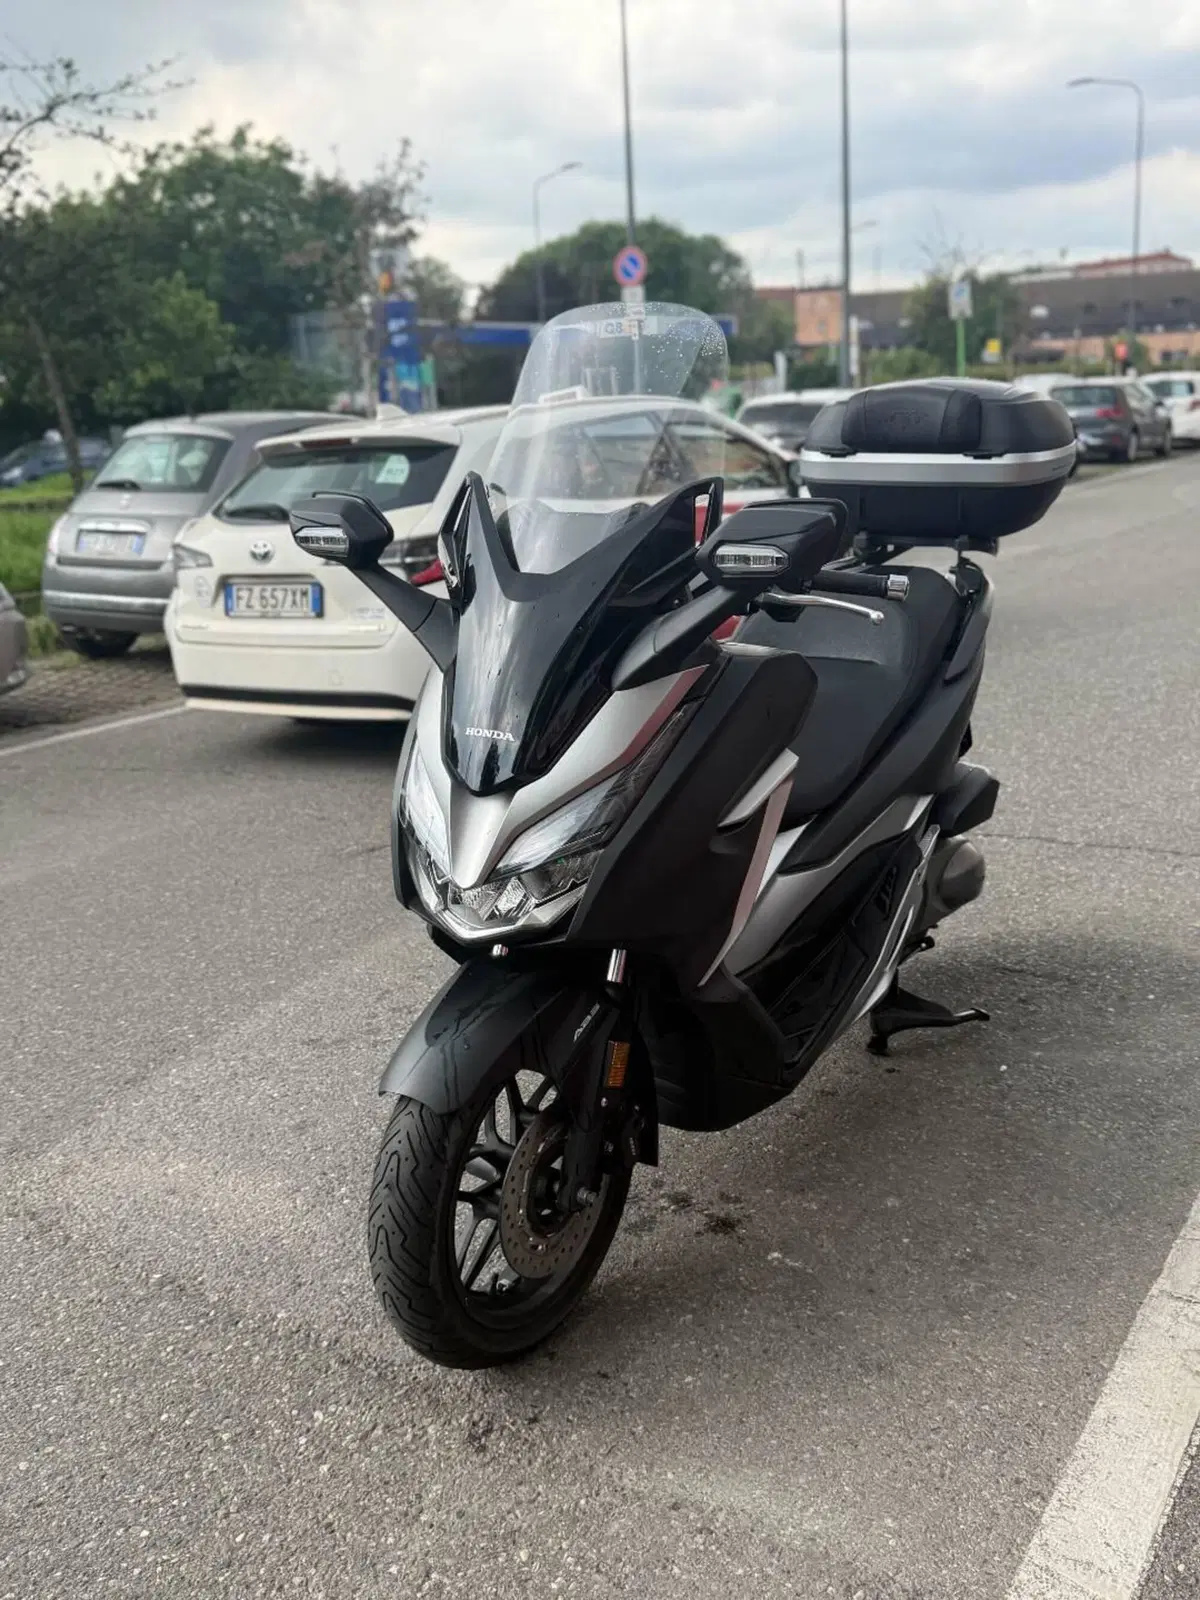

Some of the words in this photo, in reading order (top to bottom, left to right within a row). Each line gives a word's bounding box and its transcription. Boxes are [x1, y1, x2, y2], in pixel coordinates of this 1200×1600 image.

[236, 587, 255, 609] FZ
[260, 587, 310, 609] 657XM
[464, 727, 516, 742] HONDA
